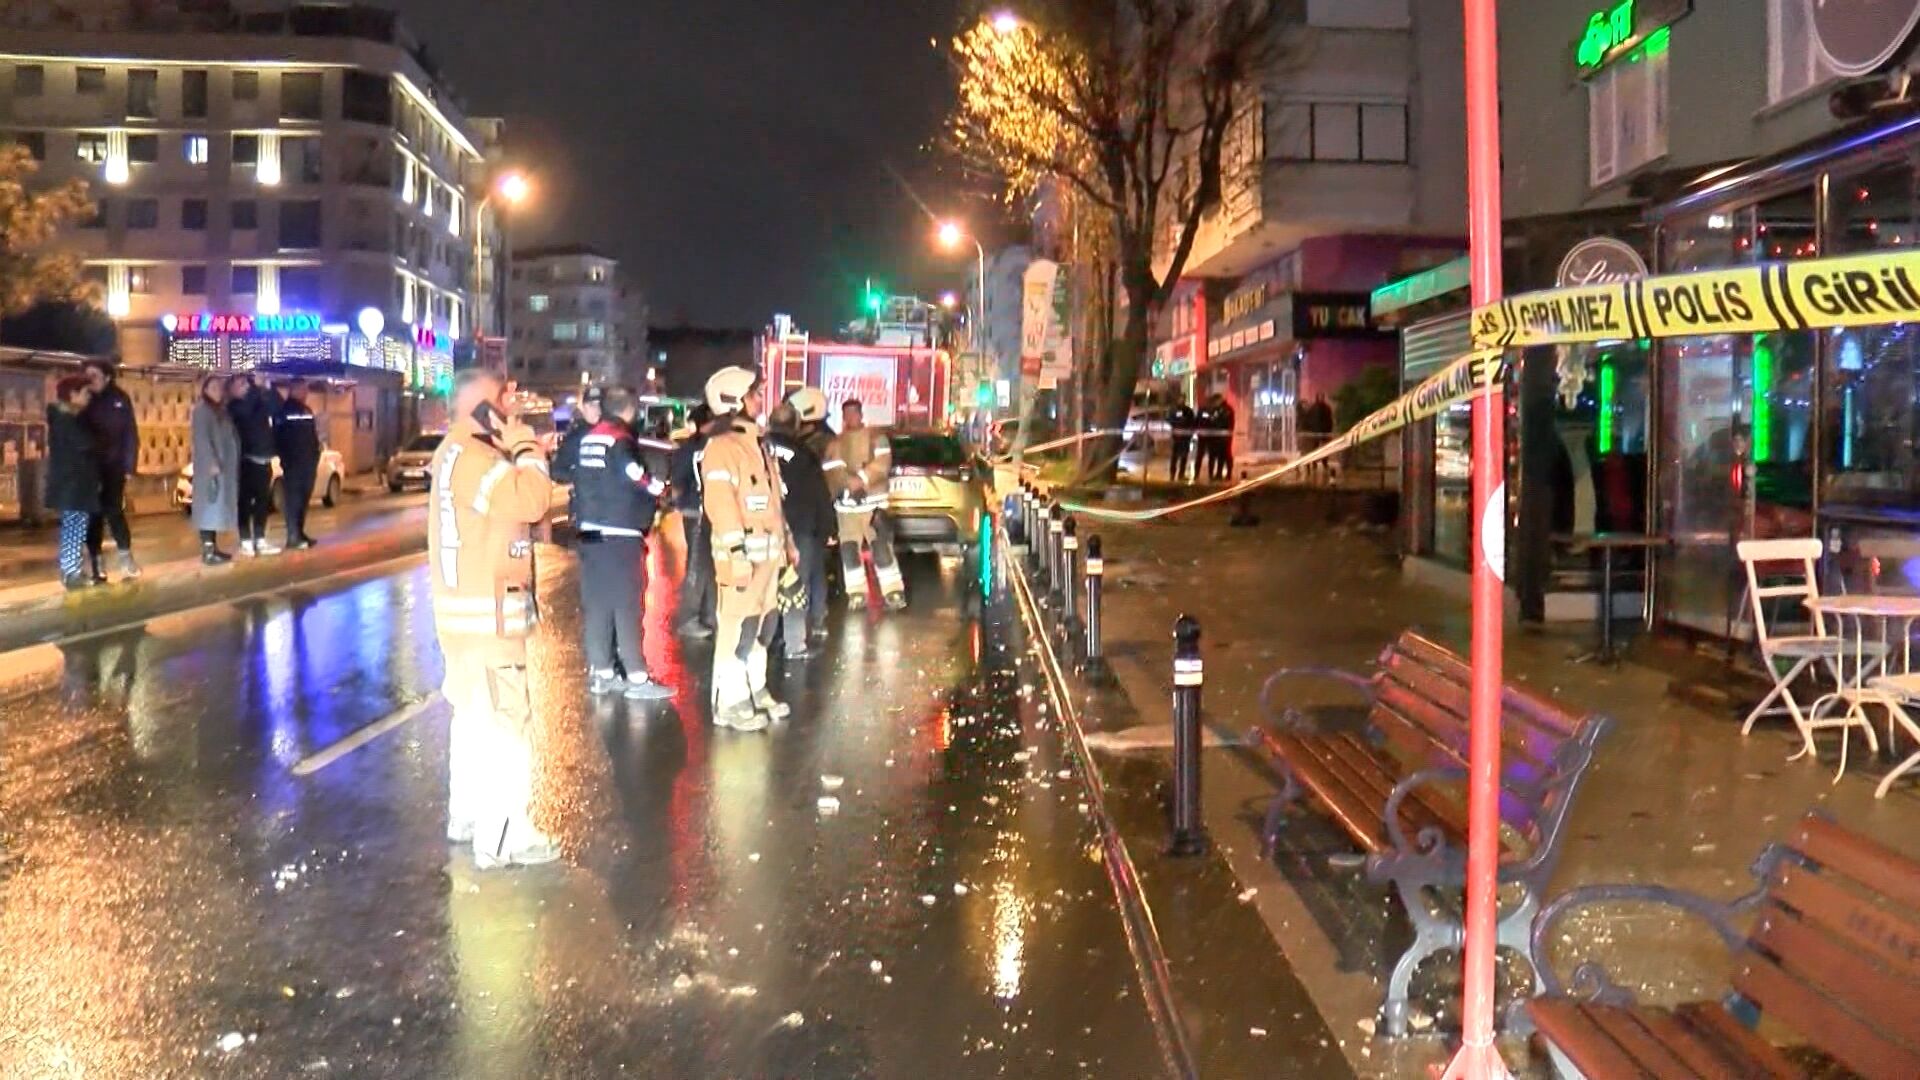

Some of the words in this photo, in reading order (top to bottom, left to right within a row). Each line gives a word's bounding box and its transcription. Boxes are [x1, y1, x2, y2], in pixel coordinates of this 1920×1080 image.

[177, 314, 251, 332] RE/MAX
[256, 314, 321, 332] ENJOY
[1519, 294, 1619, 336] GİRİLMEZ
[1653, 282, 1753, 327] POLİS
